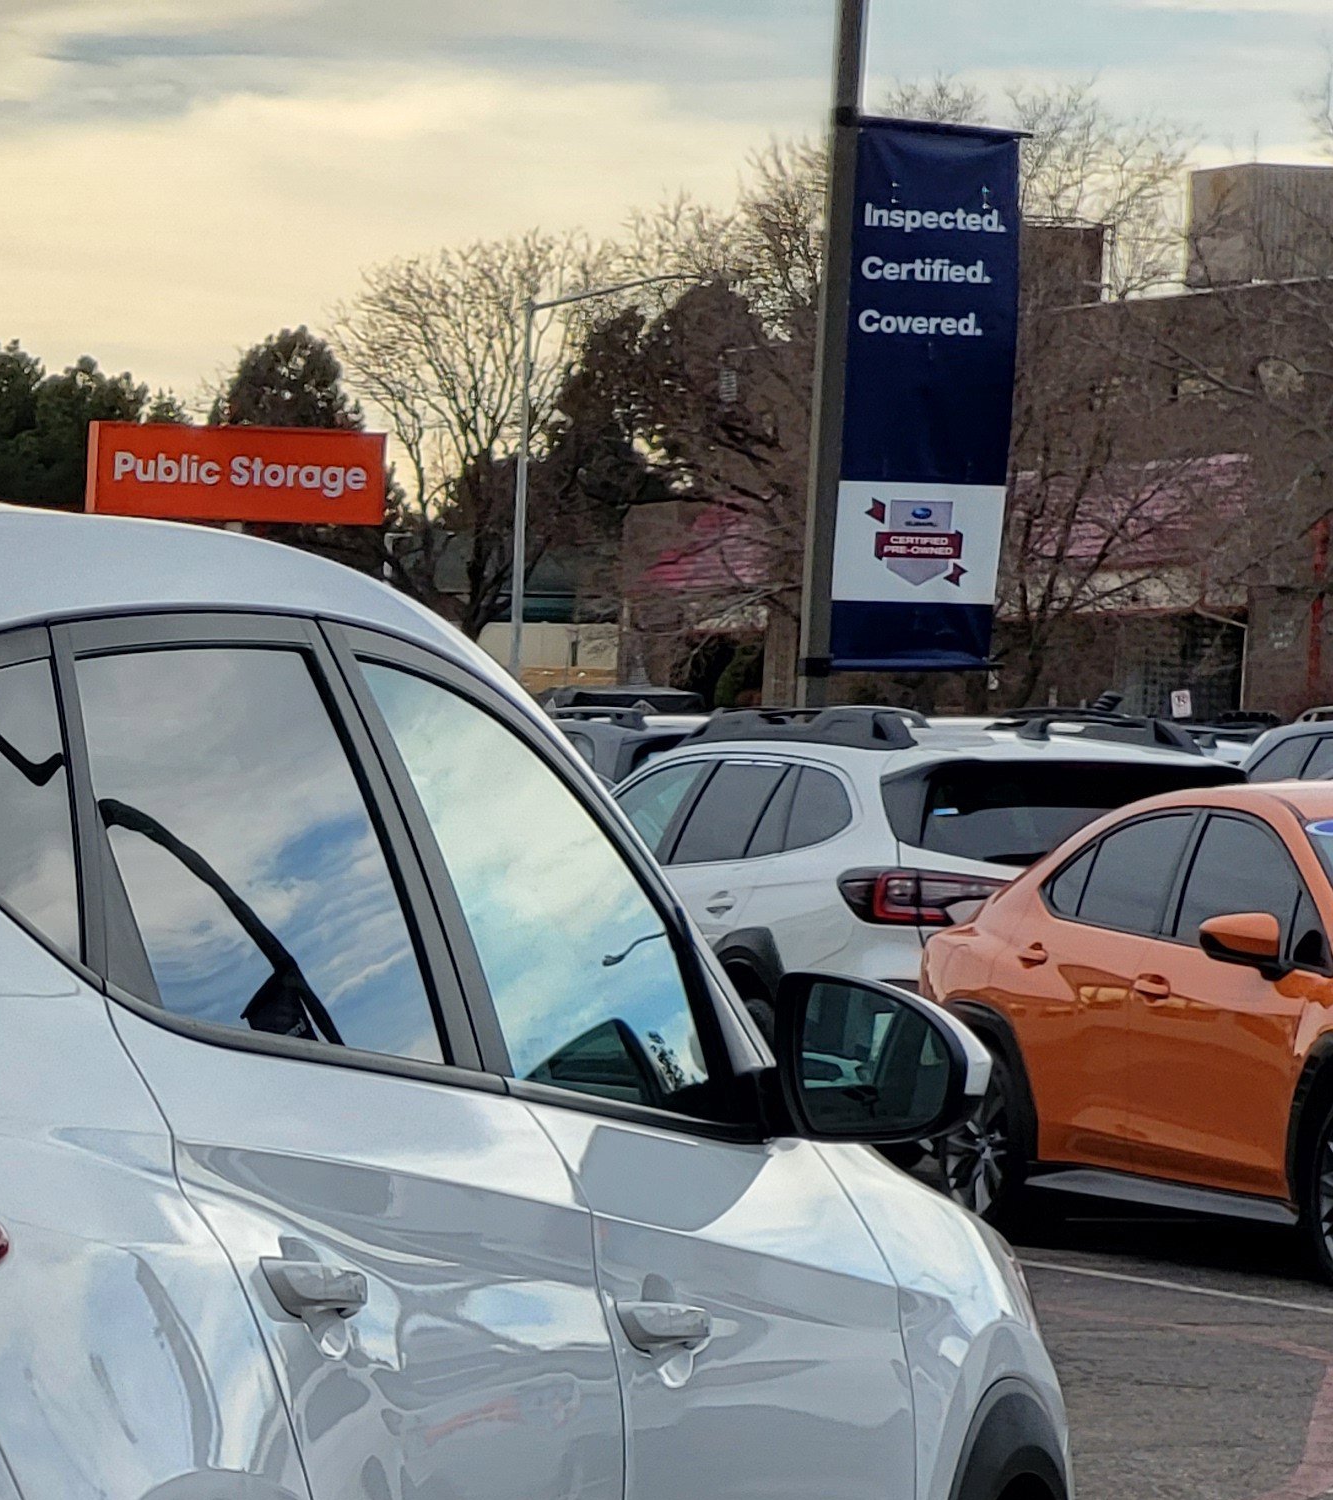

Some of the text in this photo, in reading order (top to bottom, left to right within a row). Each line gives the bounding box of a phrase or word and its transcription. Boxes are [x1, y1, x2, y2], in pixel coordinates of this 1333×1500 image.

[864, 202, 1007, 233] Inspected.
[861, 255, 992, 284] Certified.
[858, 309, 983, 336] Covered.
[113, 451, 368, 498] Public Storage
[883, 545, 953, 556] PRE-OWNED
[890, 535, 948, 546] CERTIFIED
